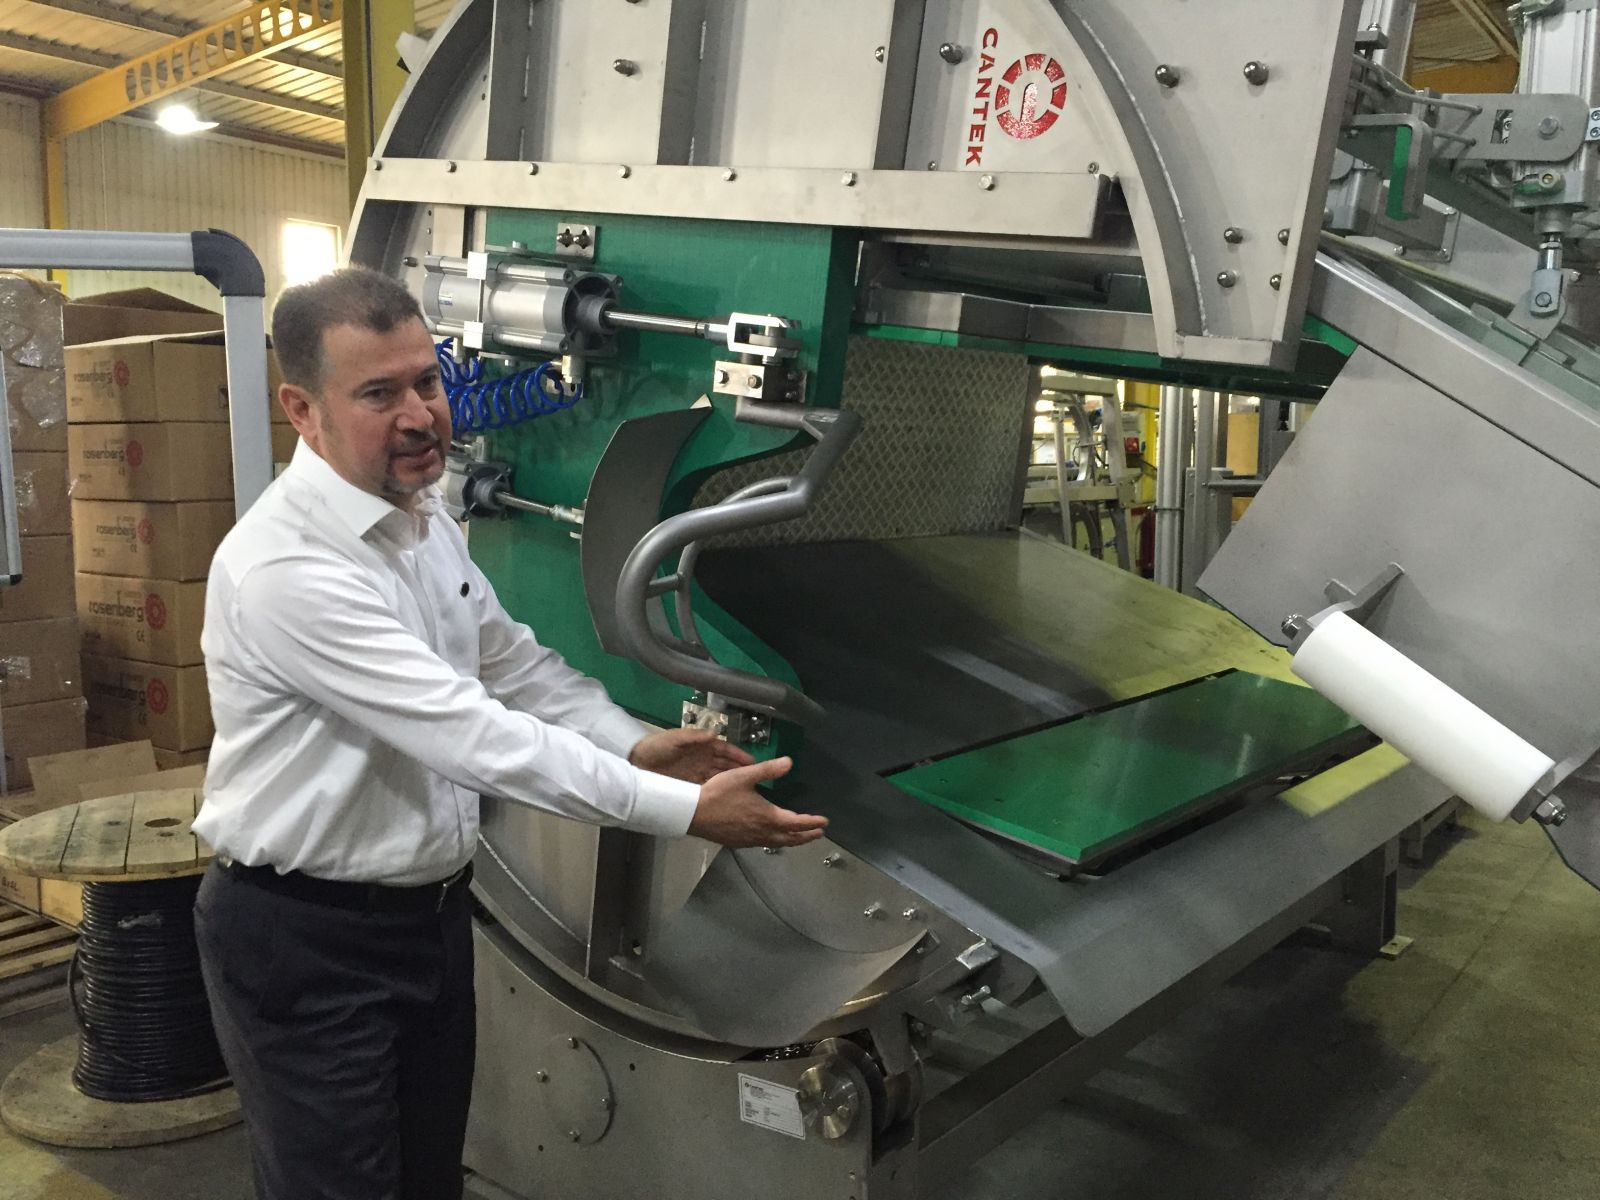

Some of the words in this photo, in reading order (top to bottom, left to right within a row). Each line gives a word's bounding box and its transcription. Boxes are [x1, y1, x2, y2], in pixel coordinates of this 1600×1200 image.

[965, 27, 999, 167] CANTEK
[83, 440, 124, 462] rosenberg
[96, 516, 136, 540] rosenberg
[88, 590, 145, 622] rosenberg
